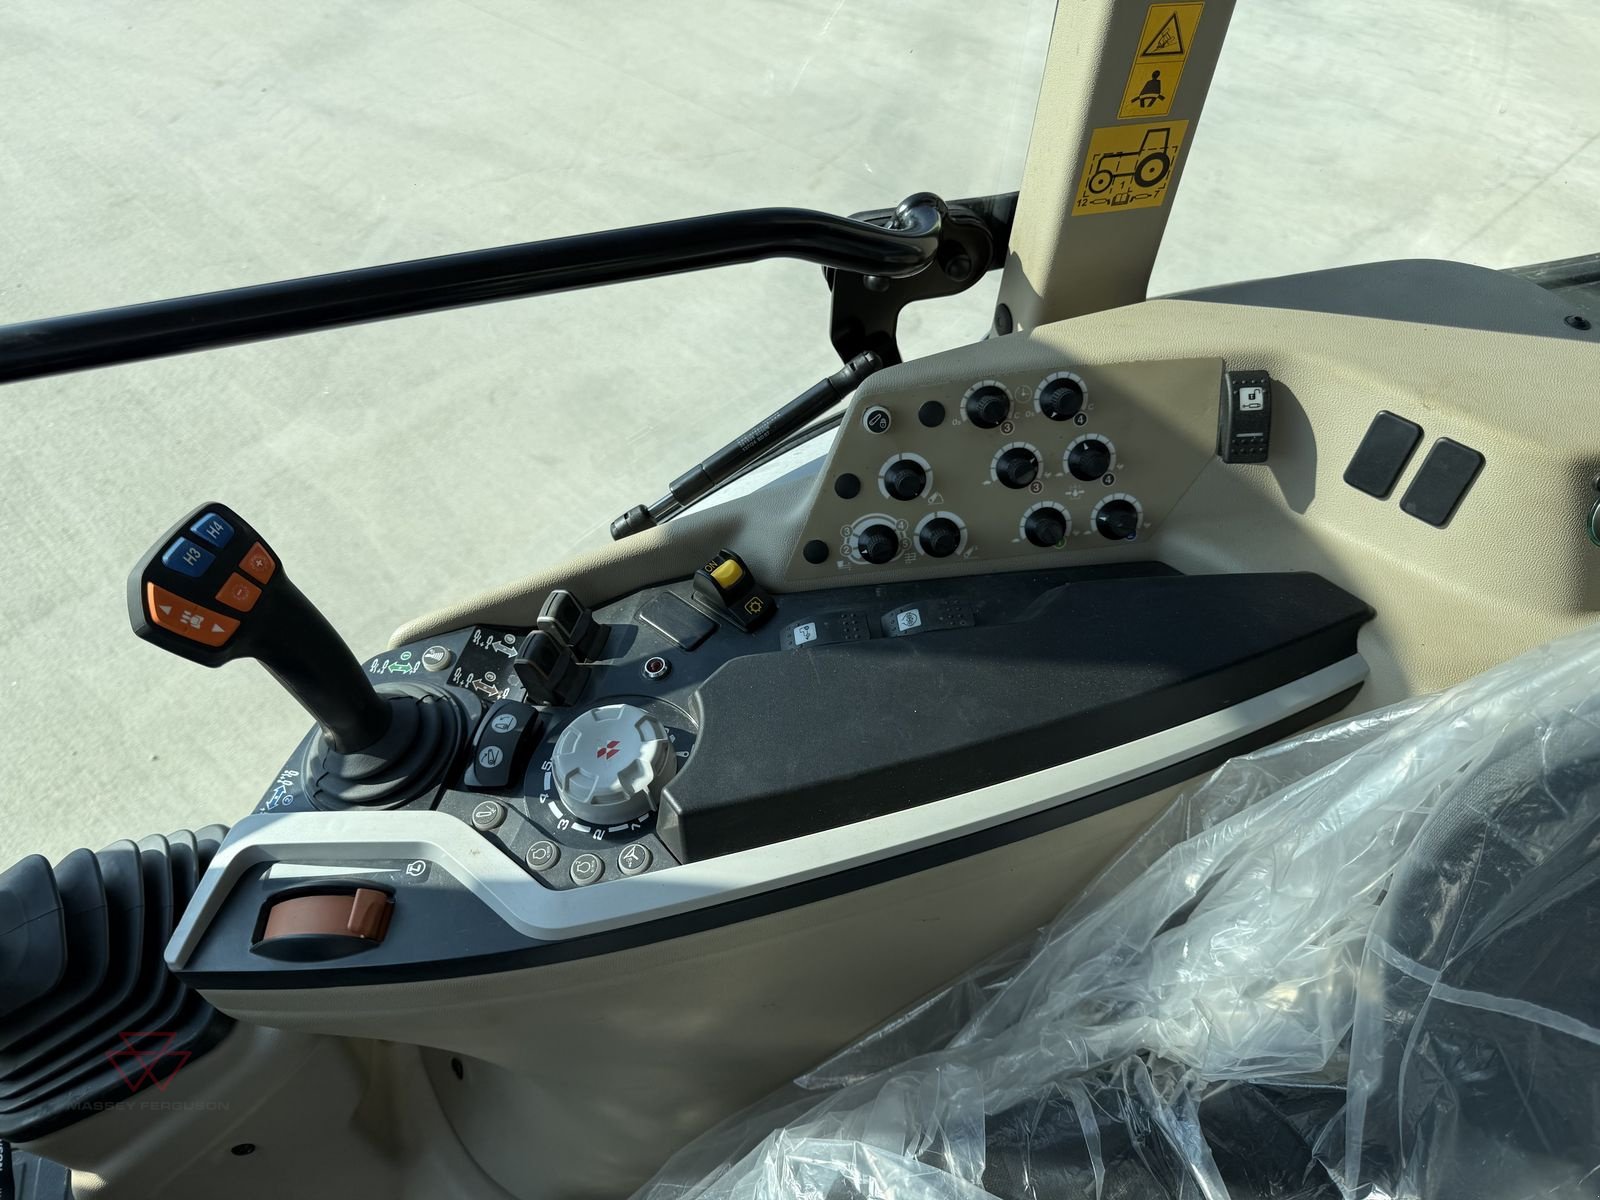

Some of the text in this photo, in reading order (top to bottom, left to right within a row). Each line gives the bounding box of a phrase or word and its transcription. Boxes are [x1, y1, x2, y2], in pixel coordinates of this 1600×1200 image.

[1154, 190, 1161, 198] 7
[1077, 199, 1088, 207] 12
[1077, 414, 1084, 424] 4
[1003, 423, 1011, 433] 3
[1104, 474, 1112, 485] 4
[1032, 482, 1040, 492] 3
[206, 522, 224, 539] H4
[183, 548, 201, 565] H3
[704, 560, 718, 572] ON
[541, 761, 553, 771] 5
[539, 793, 549, 804] 4
[557, 819, 569, 830] 3
[592, 829, 605, 840] 2
